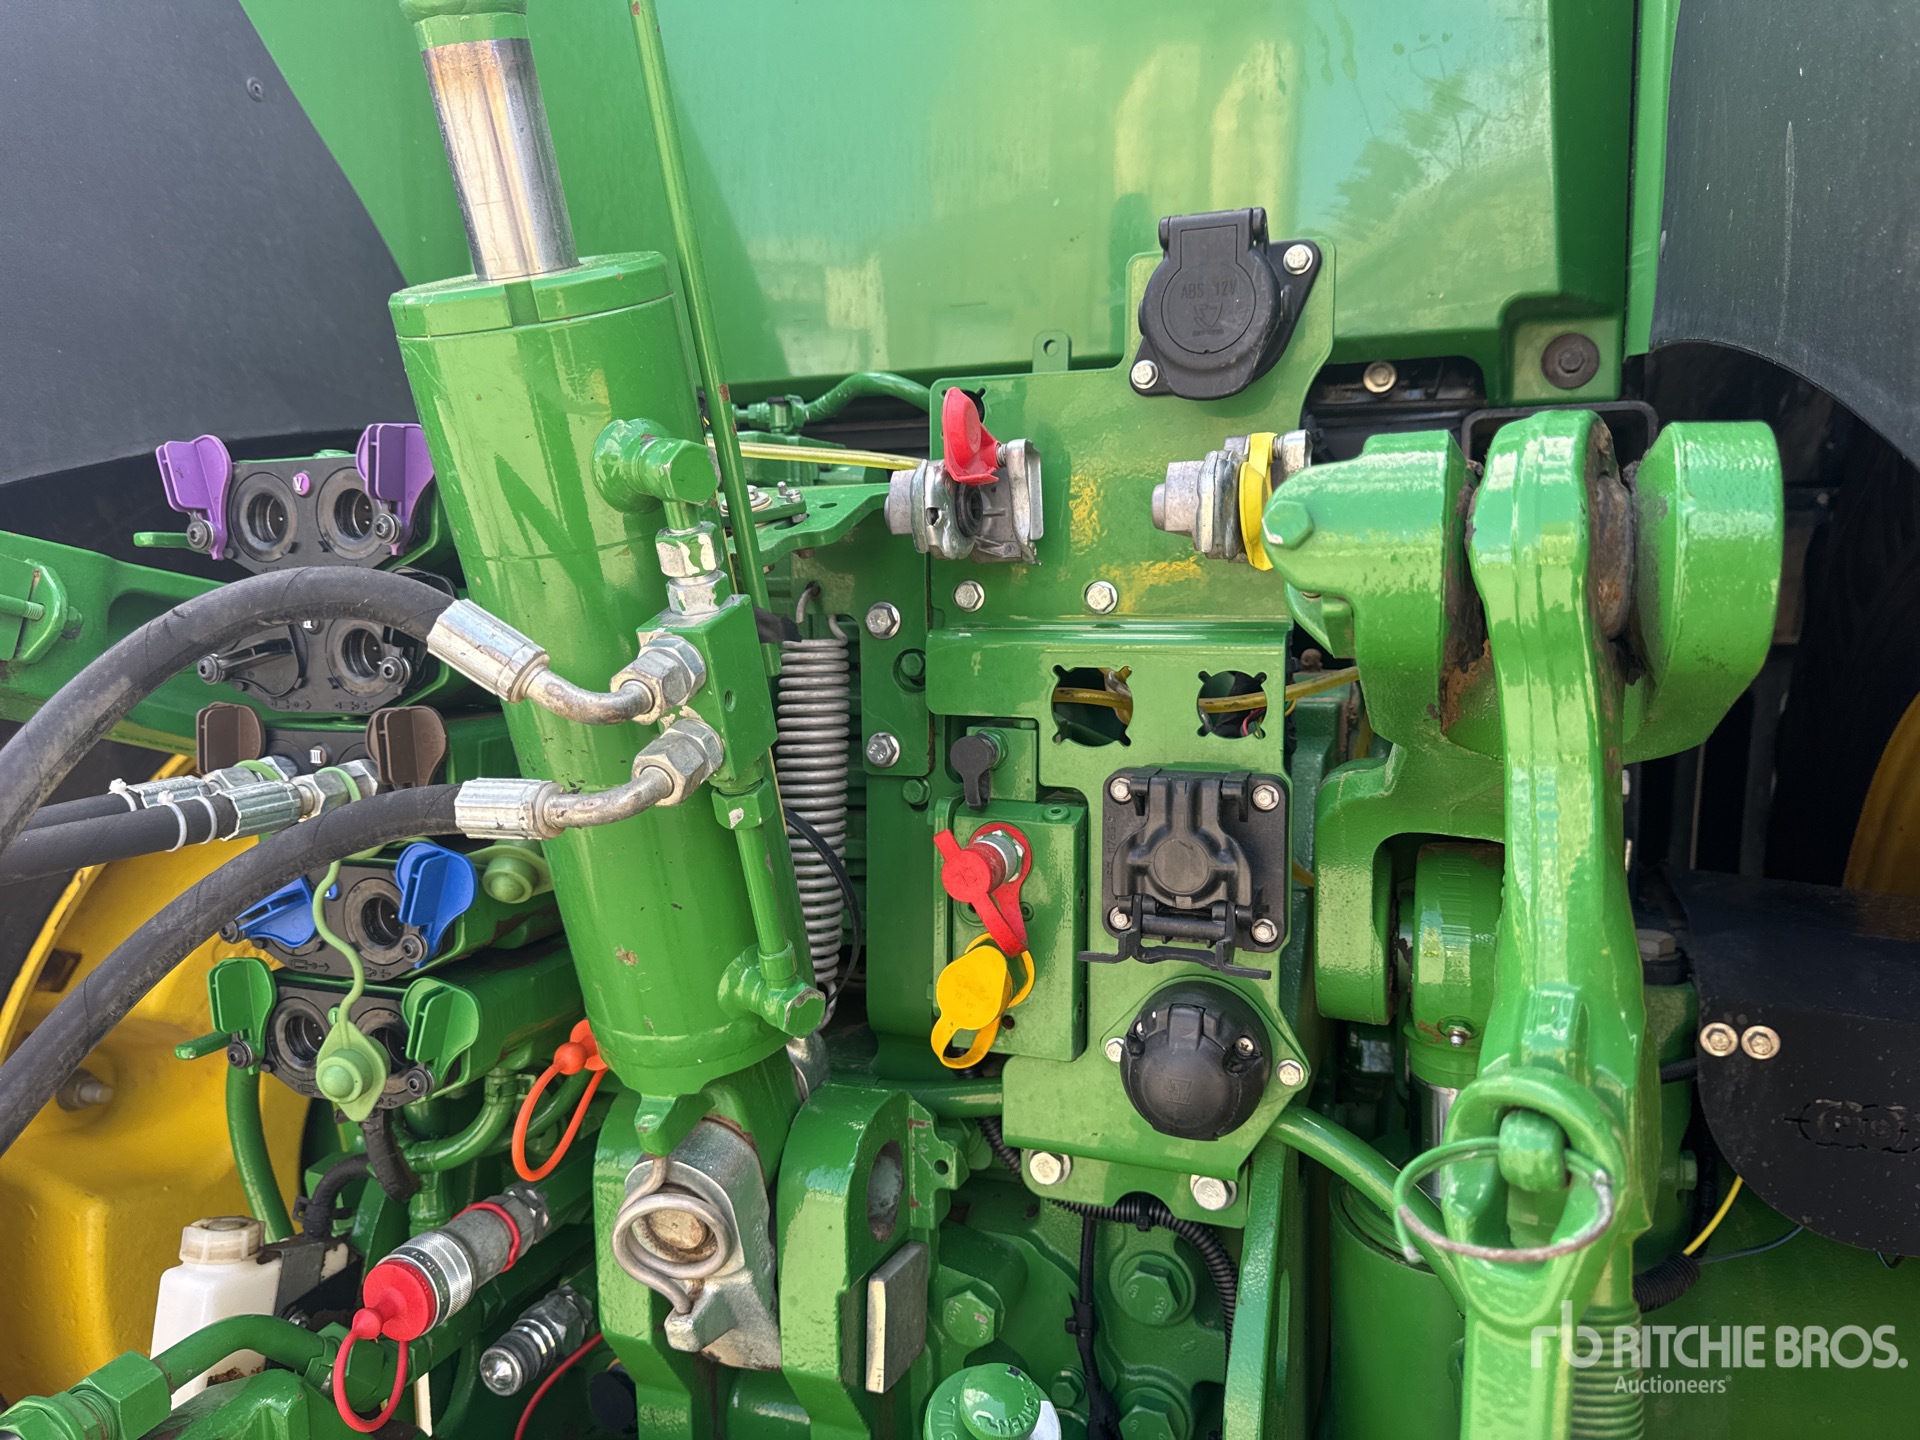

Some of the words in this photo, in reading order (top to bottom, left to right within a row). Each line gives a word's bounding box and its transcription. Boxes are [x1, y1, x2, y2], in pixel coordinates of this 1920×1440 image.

[1181, 283, 1204, 299] ABS
[1216, 278, 1237, 296] 12V
[311, 749, 322, 764] III
